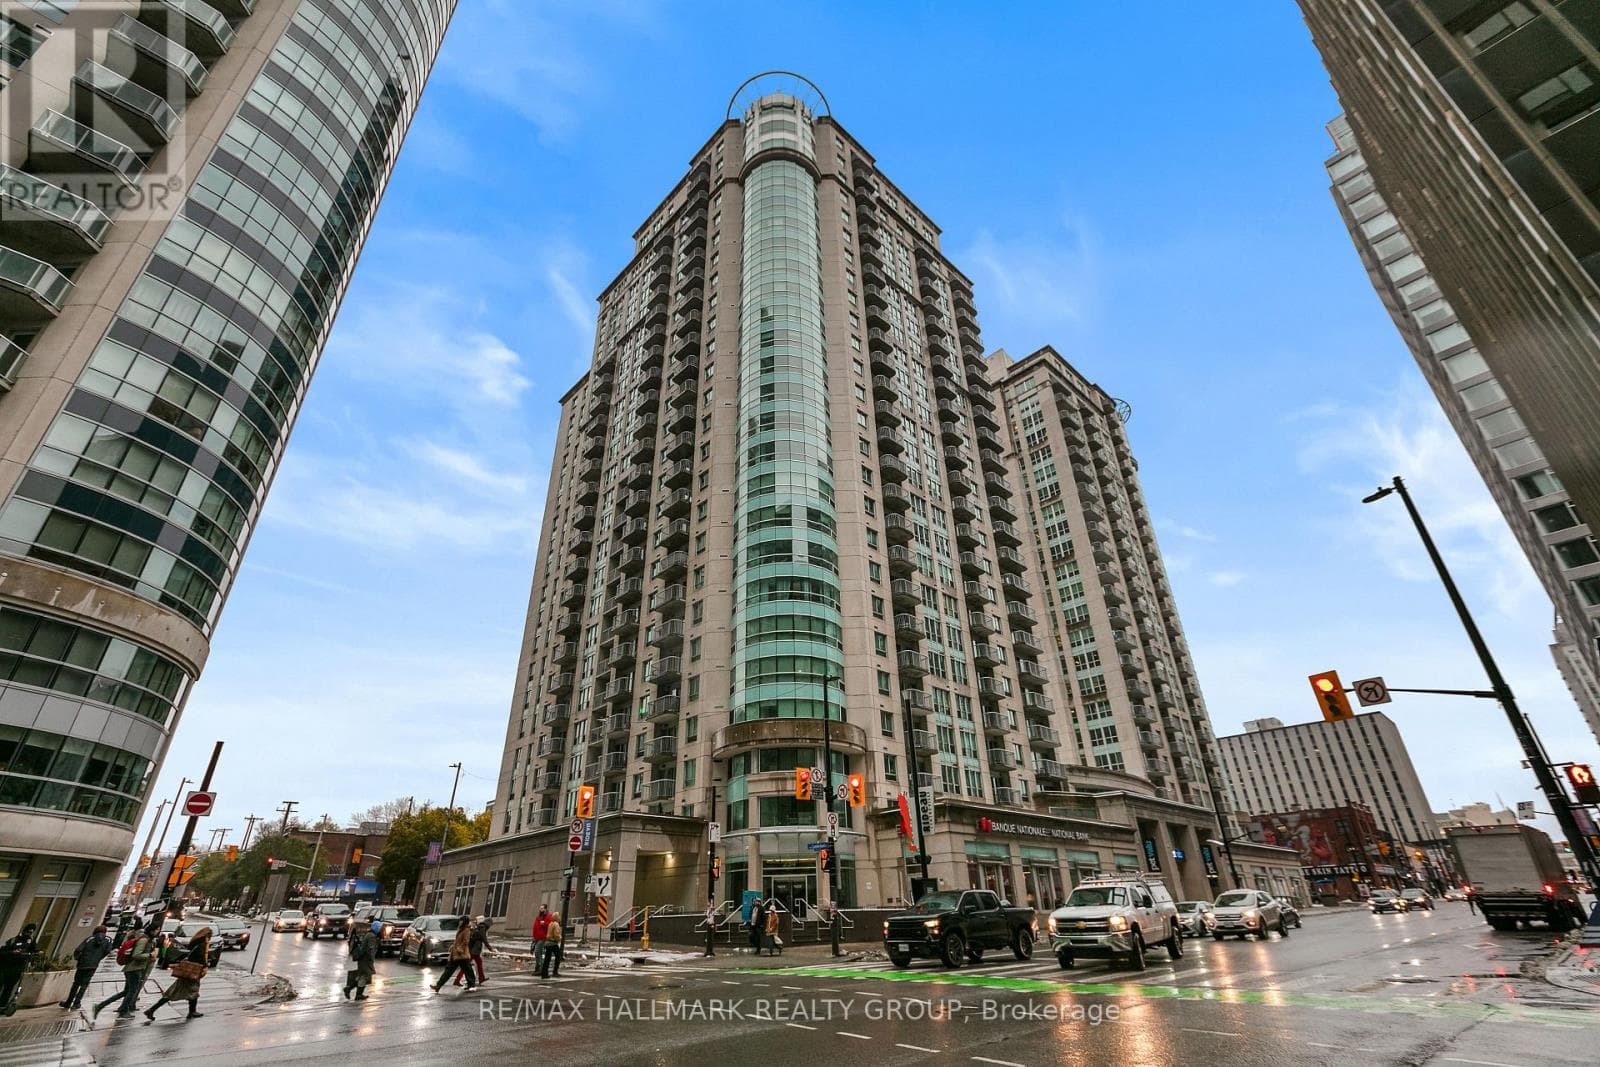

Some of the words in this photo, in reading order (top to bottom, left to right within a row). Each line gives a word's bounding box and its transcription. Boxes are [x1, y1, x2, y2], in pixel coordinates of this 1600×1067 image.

[991, 822, 1016, 833] BANQUE
[1016, 826, 1046, 836] NATIONALE
[1051, 829, 1075, 839] NATIONAL
[1312, 867, 1331, 875] SKIN
